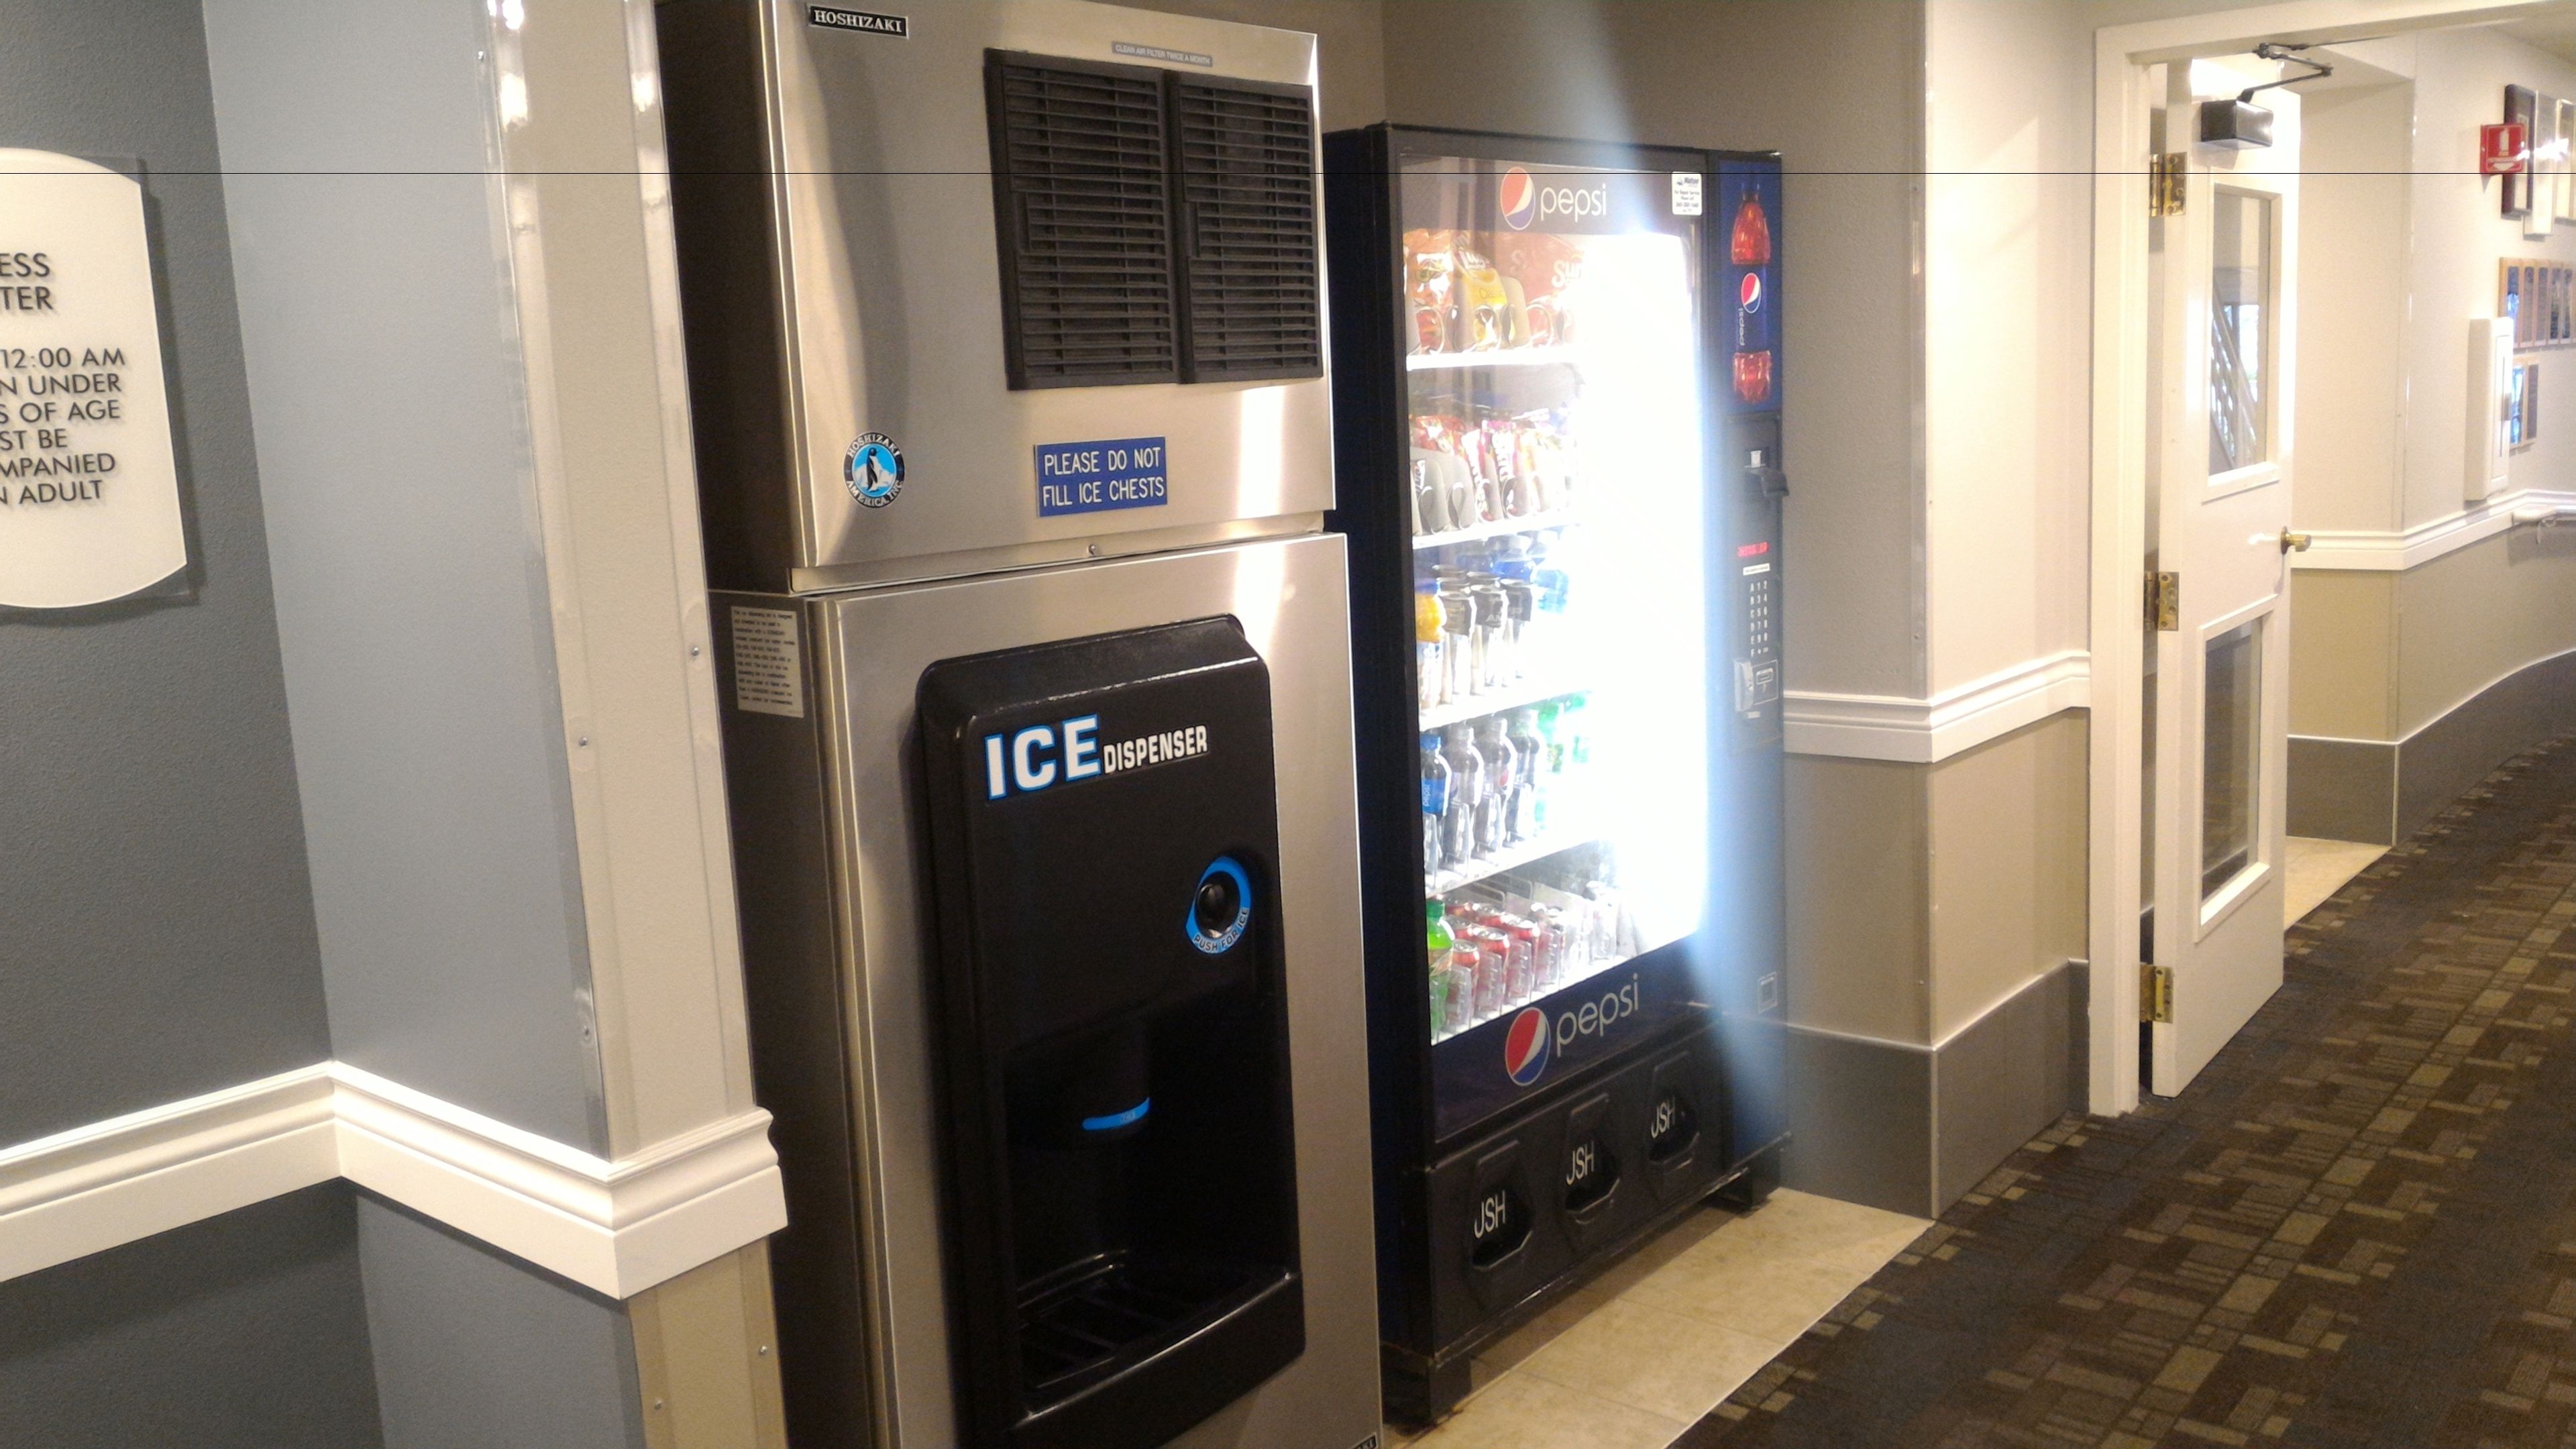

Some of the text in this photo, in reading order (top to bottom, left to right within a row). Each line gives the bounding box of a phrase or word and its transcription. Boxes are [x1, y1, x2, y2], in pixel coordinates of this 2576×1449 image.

[814, 9, 902, 32] HOSHIZAKI
[1116, 44, 1135, 53] CLEAN
[1136, 47, 1146, 55] AIR
[1146, 48, 1165, 58] FILTER
[1166, 51, 1184, 61] TWICE
[1189, 55, 1210, 64] MONTH
[1540, 183, 1607, 223] pepsi
[0, 347, 125, 368] 12:00 AM
[28, 372, 122, 396] UNDER
[19, 402, 57, 423] OF
[68, 400, 121, 421] AGE
[38, 428, 68, 449] BE
[847, 434, 901, 459] HOSHIZAKI
[1044, 447, 1161, 476] PLEASE DO NOT
[19, 479, 103, 504] ADULT
[1042, 476, 1165, 507] FILL ICE CHESTS
[984, 714, 1208, 800] ICE DISPENSER
[1194, 908, 1249, 951] PUSH FOR ICE
[1556, 973, 1639, 1058] pepsi
